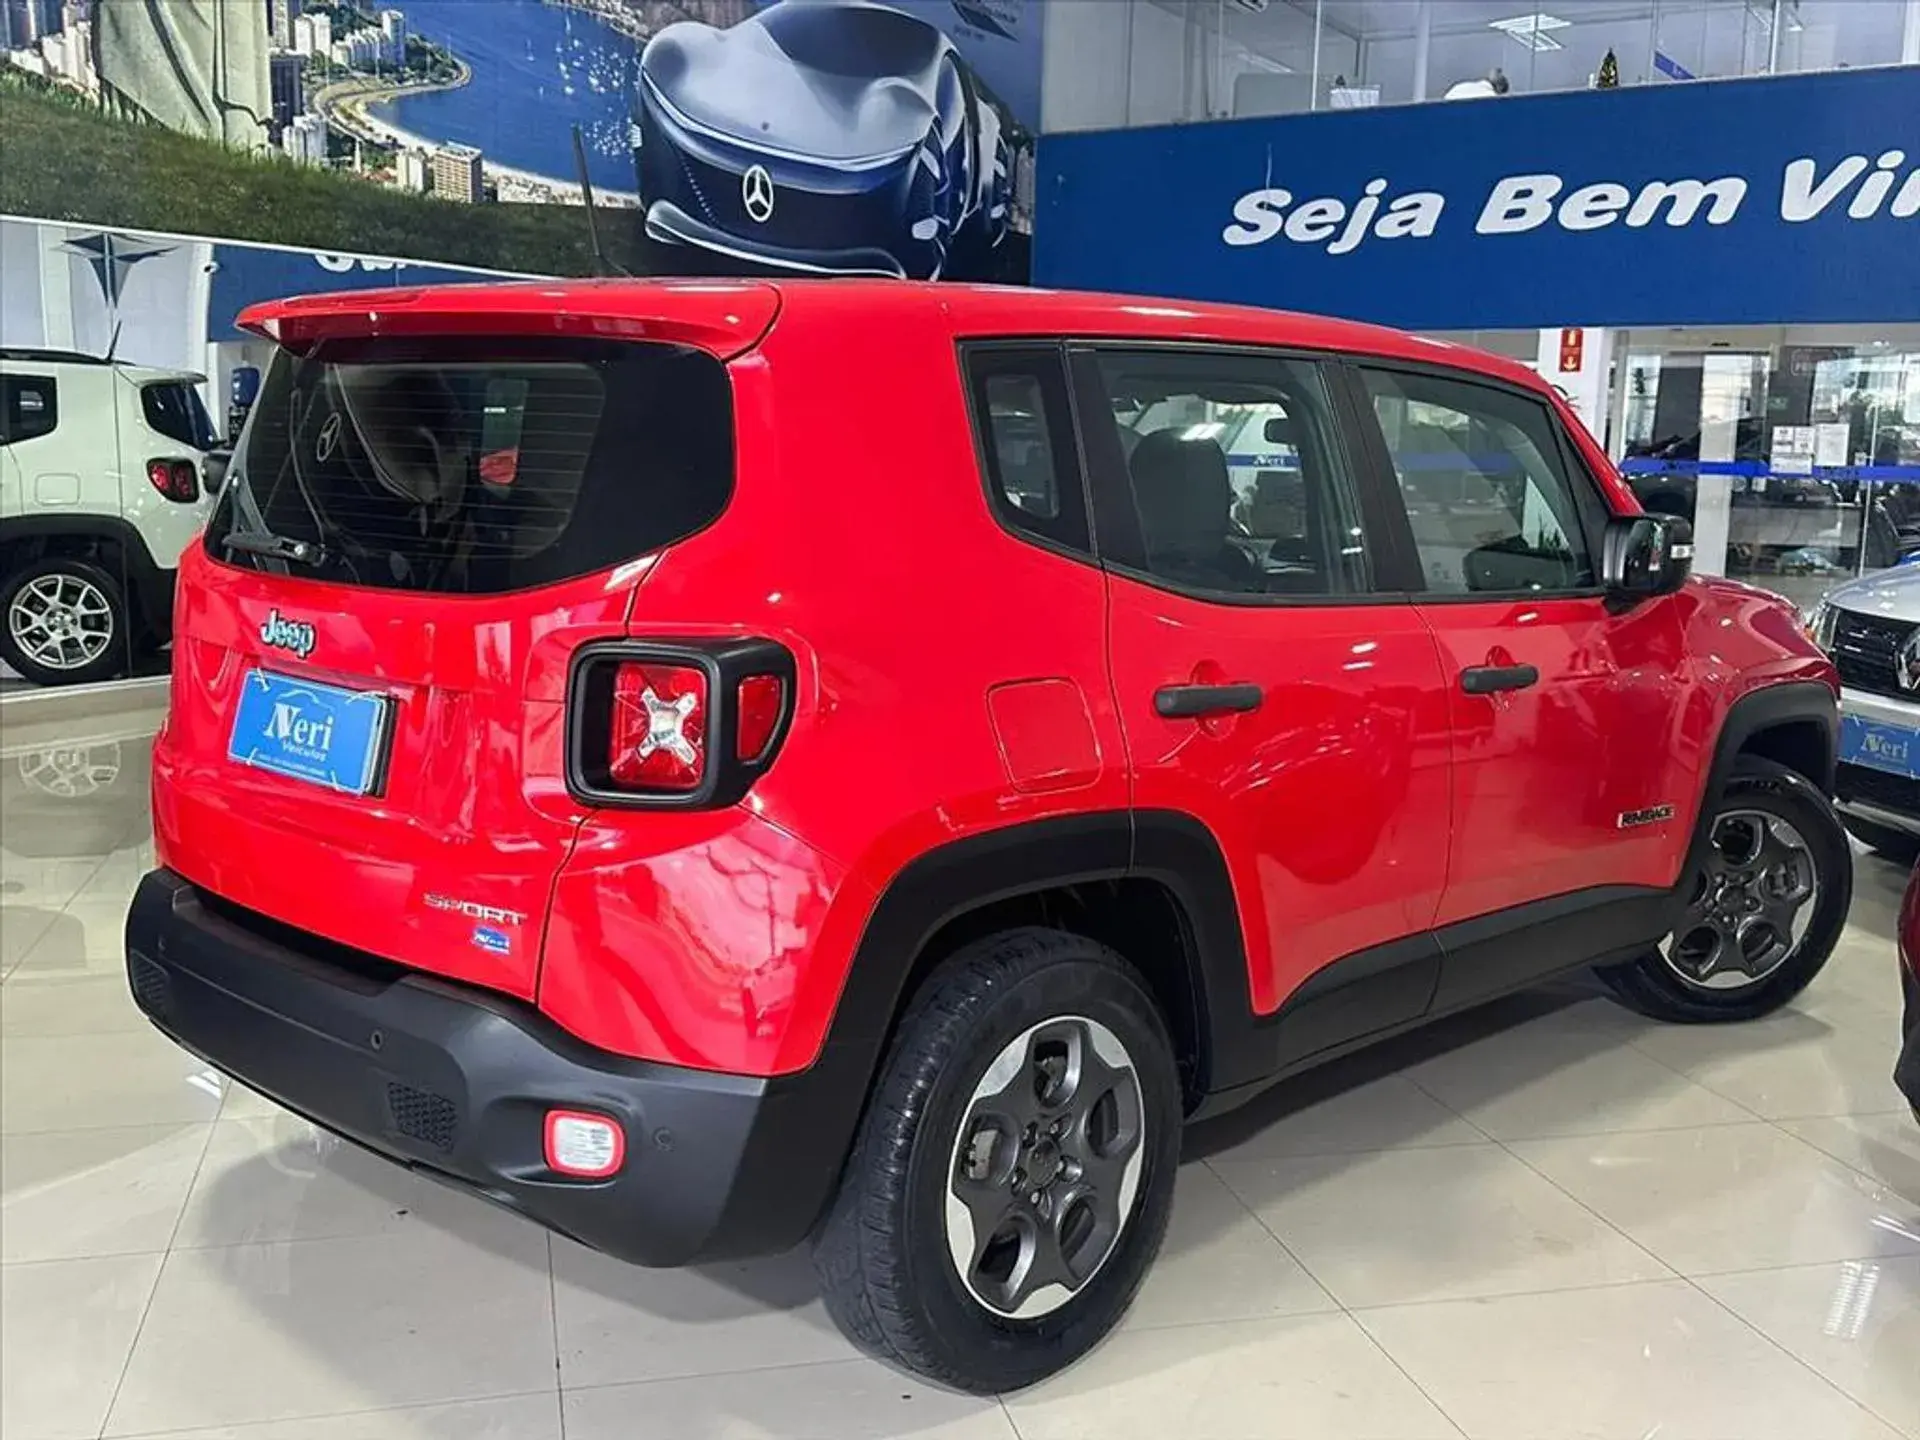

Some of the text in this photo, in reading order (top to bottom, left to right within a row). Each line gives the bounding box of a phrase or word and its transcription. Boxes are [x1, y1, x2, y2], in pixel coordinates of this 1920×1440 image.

[1222, 177, 1444, 254] Seja
[1475, 174, 1747, 234] Bem
[260, 607, 316, 660] Jeep
[264, 702, 333, 750] Neri
[1860, 733, 1909, 759] Neri
[423, 892, 528, 926] SPORT
